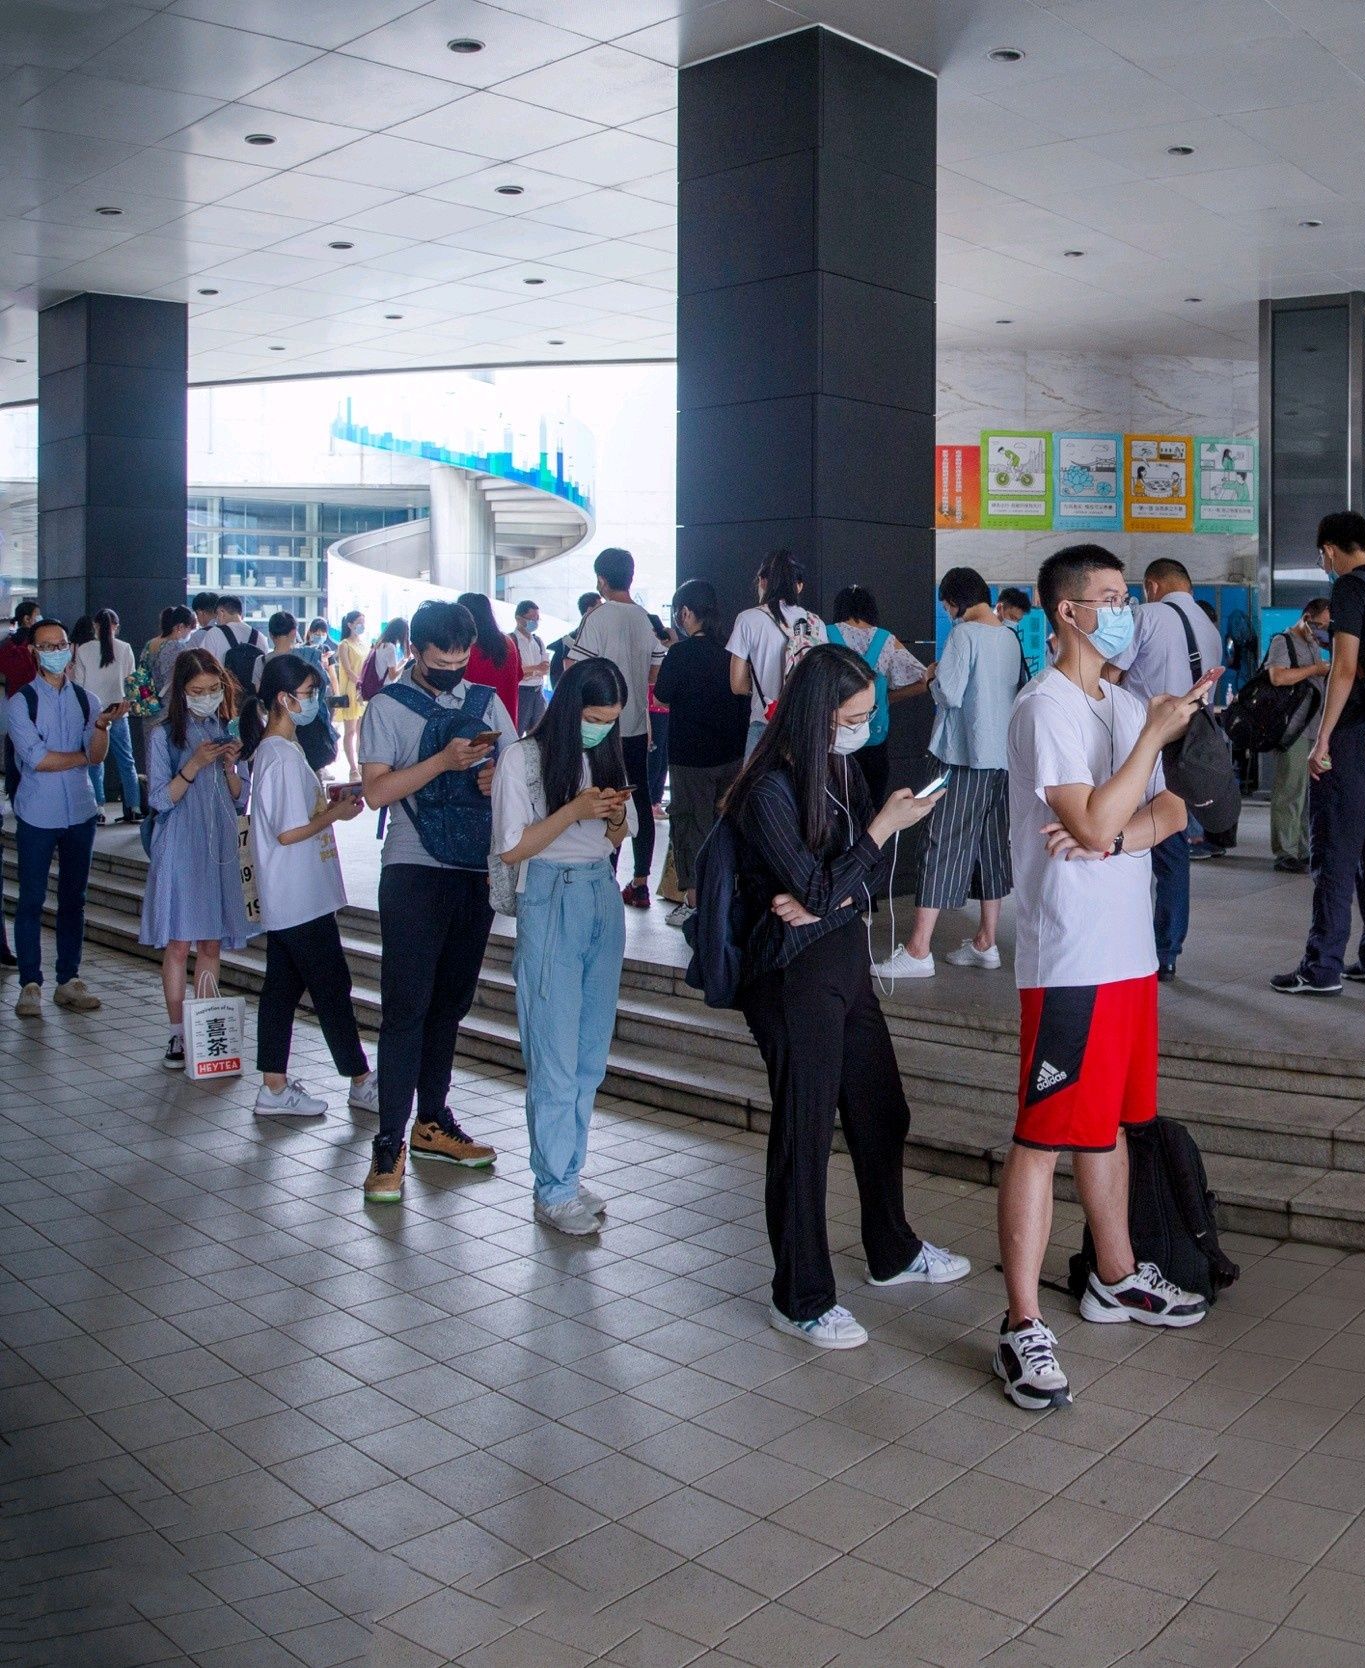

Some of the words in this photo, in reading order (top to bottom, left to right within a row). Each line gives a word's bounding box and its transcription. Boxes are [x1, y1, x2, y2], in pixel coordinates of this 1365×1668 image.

[206, 1018, 228, 1056] 喜茶
[199, 1062, 239, 1073] HEYTEA
[1036, 1071, 1067, 1091] adidas
